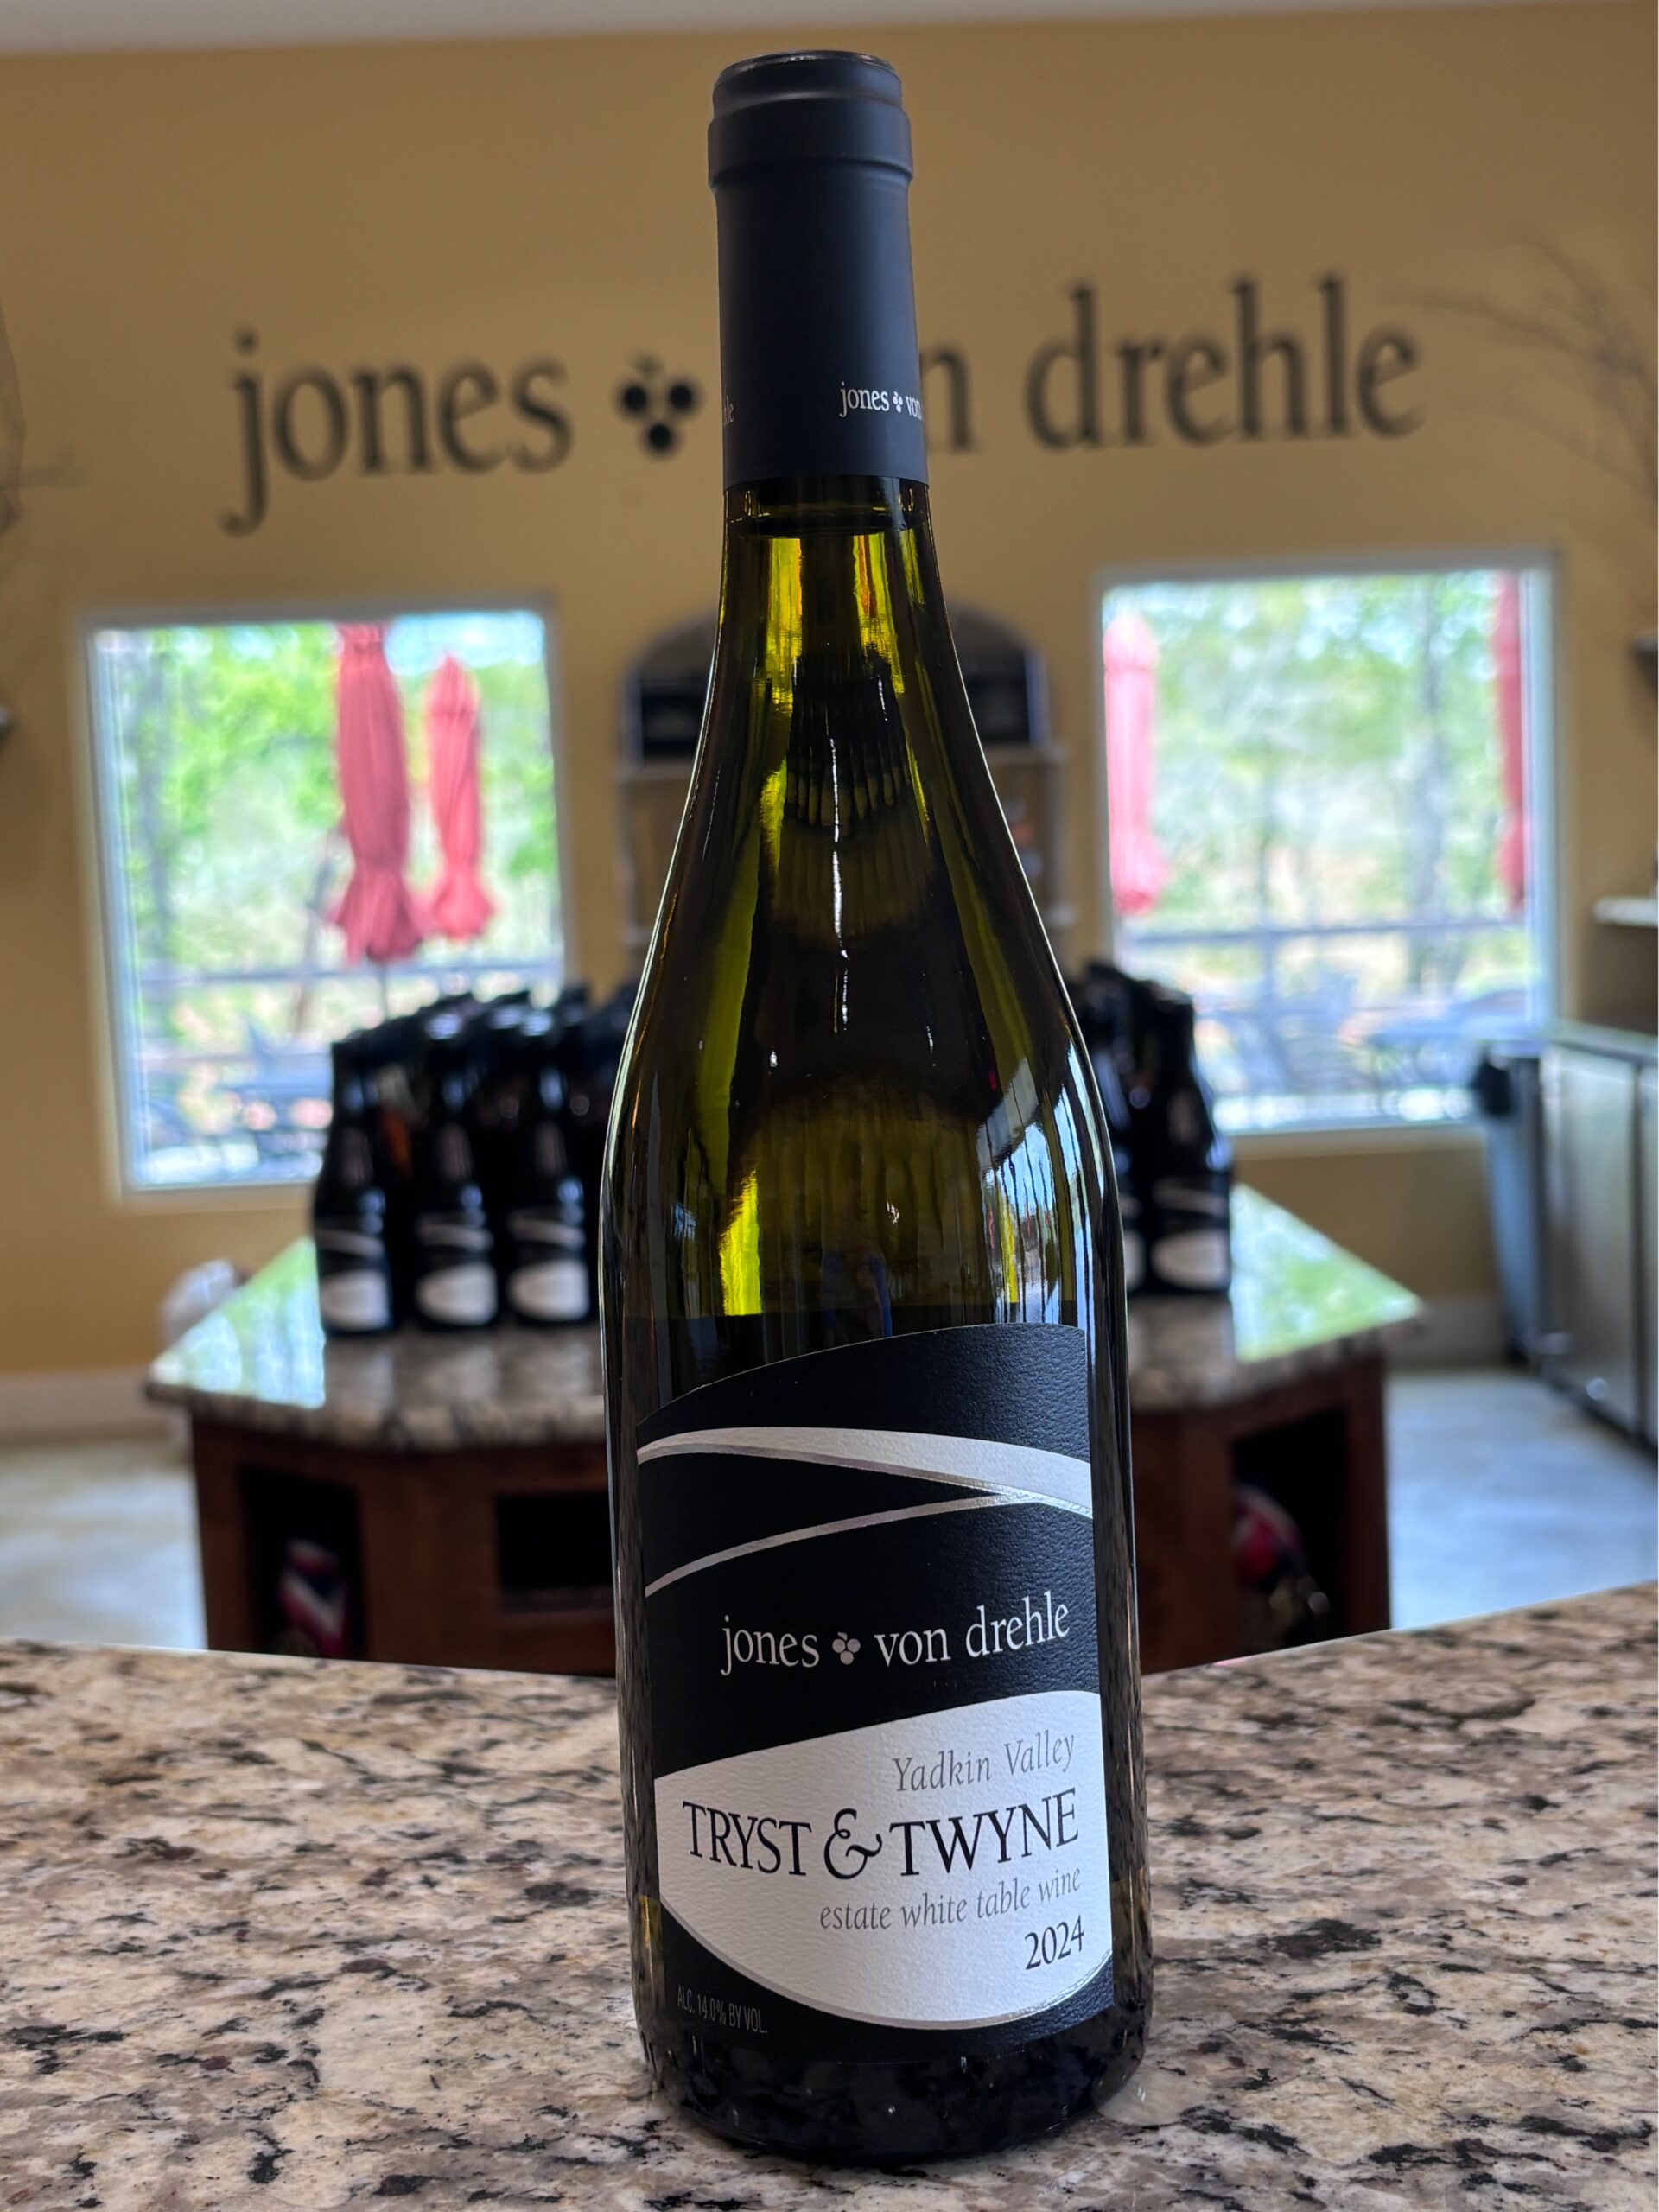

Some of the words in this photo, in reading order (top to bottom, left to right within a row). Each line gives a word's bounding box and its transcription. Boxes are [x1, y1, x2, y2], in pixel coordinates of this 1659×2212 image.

[219, 327, 575, 537] jones
[1023, 266, 1427, 444] drehle
[839, 381, 889, 417] jones
[720, 1614, 820, 1676] jones
[874, 1627, 950, 1667] von
[964, 1590, 1071, 1659] drehle
[892, 1748, 992, 1792] Yadkin
[1002, 1729, 1075, 1774] Valley
[682, 1801, 812, 1877] TRYST
[823, 1807, 883, 1880] &
[889, 1787, 1080, 1878] TWYNE
[819, 1902, 893, 1930] estate
[901, 1891, 969, 1929] white
[976, 1880, 1032, 1920] table
[1038, 1865, 1083, 1902] wine
[1023, 1914, 1086, 1971] 2024
[677, 1984, 696, 2014] ALC.
[697, 1993, 727, 2025] 14.0%
[728, 2002, 741, 2029] BY
[743, 2005, 769, 2034] VOL.
